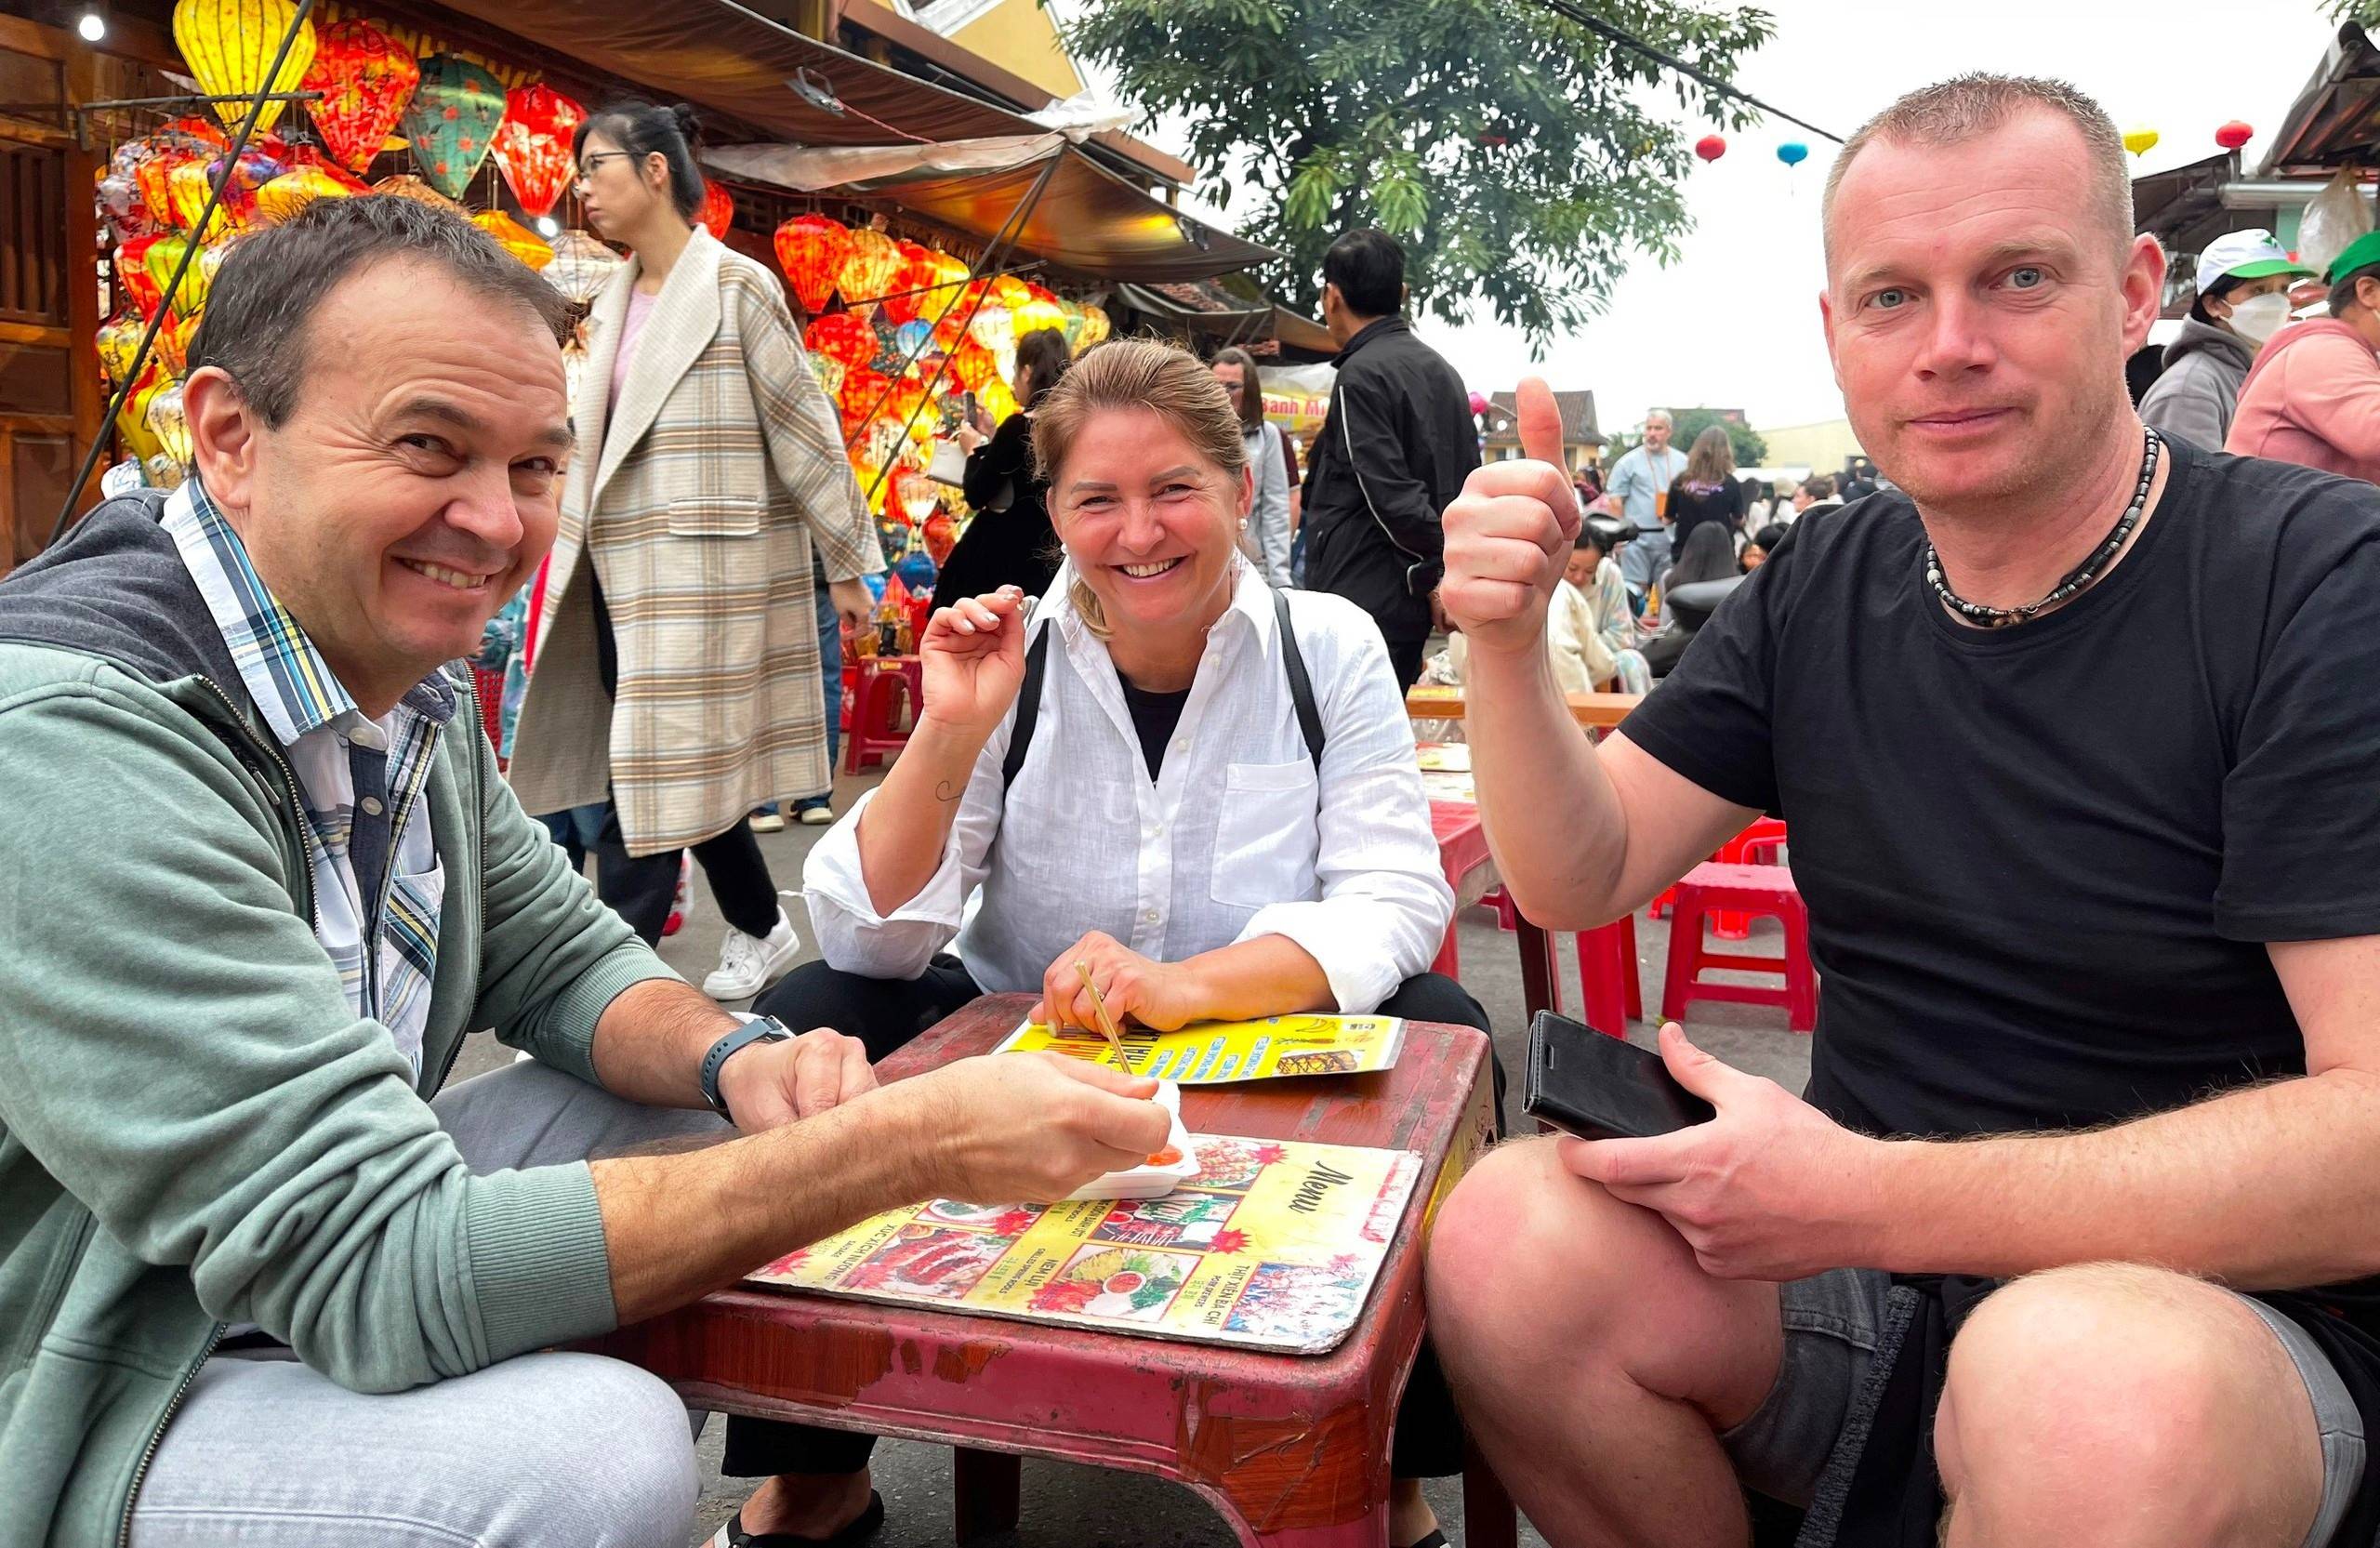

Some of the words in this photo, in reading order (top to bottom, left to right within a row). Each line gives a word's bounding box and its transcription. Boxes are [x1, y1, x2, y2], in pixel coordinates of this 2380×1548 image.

[1288, 1160, 1354, 1214] Menu
[1036, 1259, 1059, 1274] NEM
[1228, 1264, 1250, 1280] THỊT
